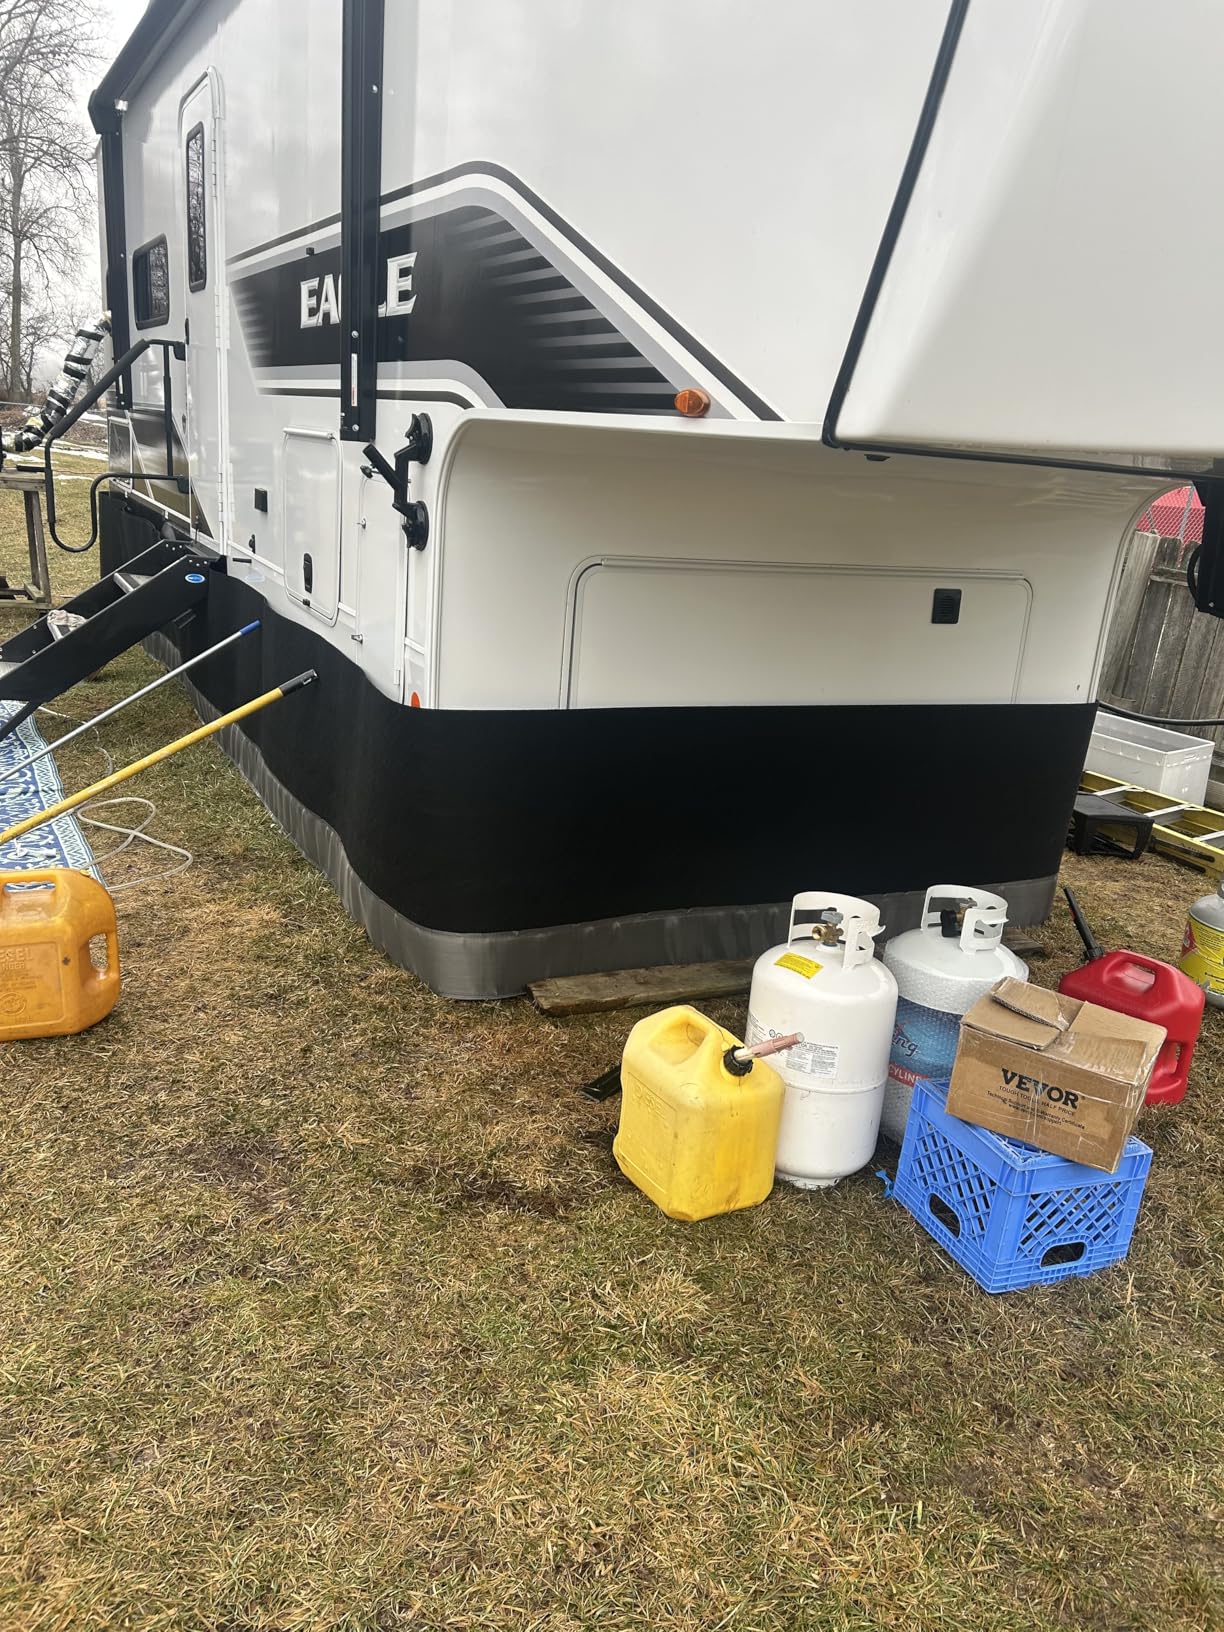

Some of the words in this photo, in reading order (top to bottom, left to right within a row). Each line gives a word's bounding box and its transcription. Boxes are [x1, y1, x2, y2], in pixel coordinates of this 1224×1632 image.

[300, 252, 418, 329] EAE
[999, 1085, 1019, 1097] TOUGH
[1001, 1068, 1079, 1109] VEVOR
